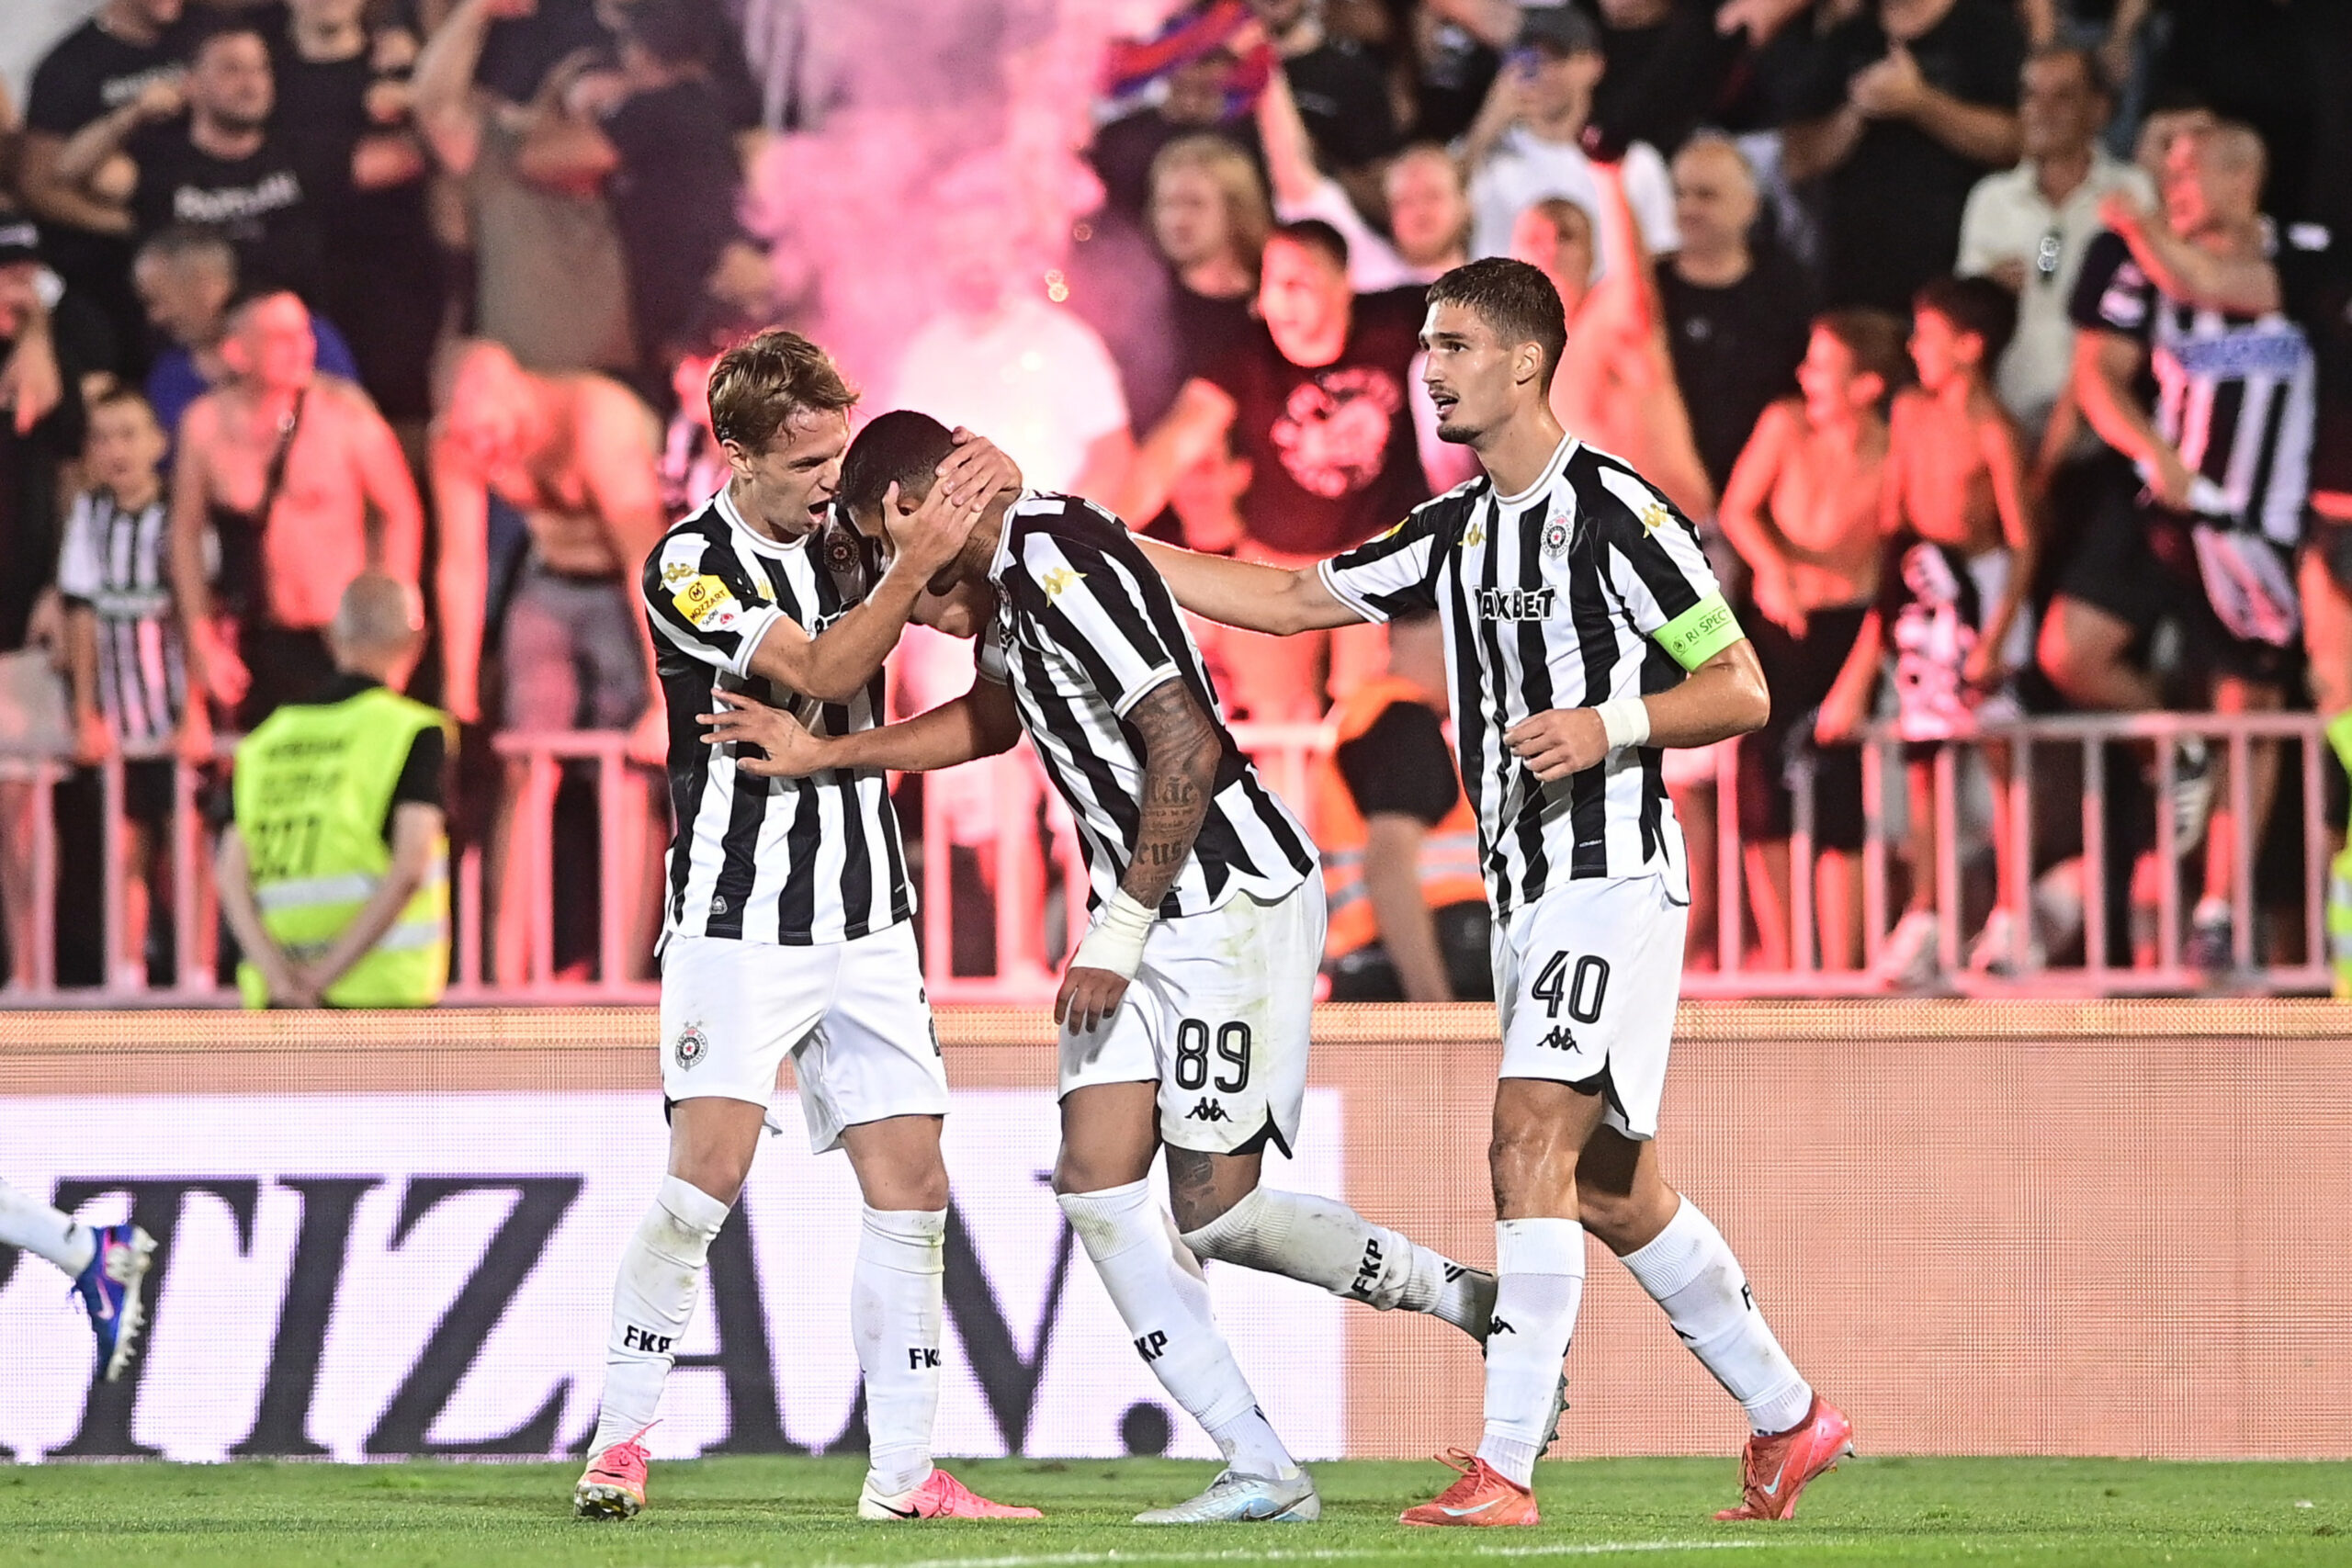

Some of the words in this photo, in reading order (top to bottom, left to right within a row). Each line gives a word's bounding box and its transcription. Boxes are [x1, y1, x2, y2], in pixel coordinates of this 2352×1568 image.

[689, 590, 726, 622] MOZZART
[1532, 950, 1611, 1024] 40
[1175, 1018, 1251, 1093] 89
[1351, 1238, 1383, 1297] FKP
[624, 1325, 672, 1353] FKP
[909, 1348, 941, 1370] FK
